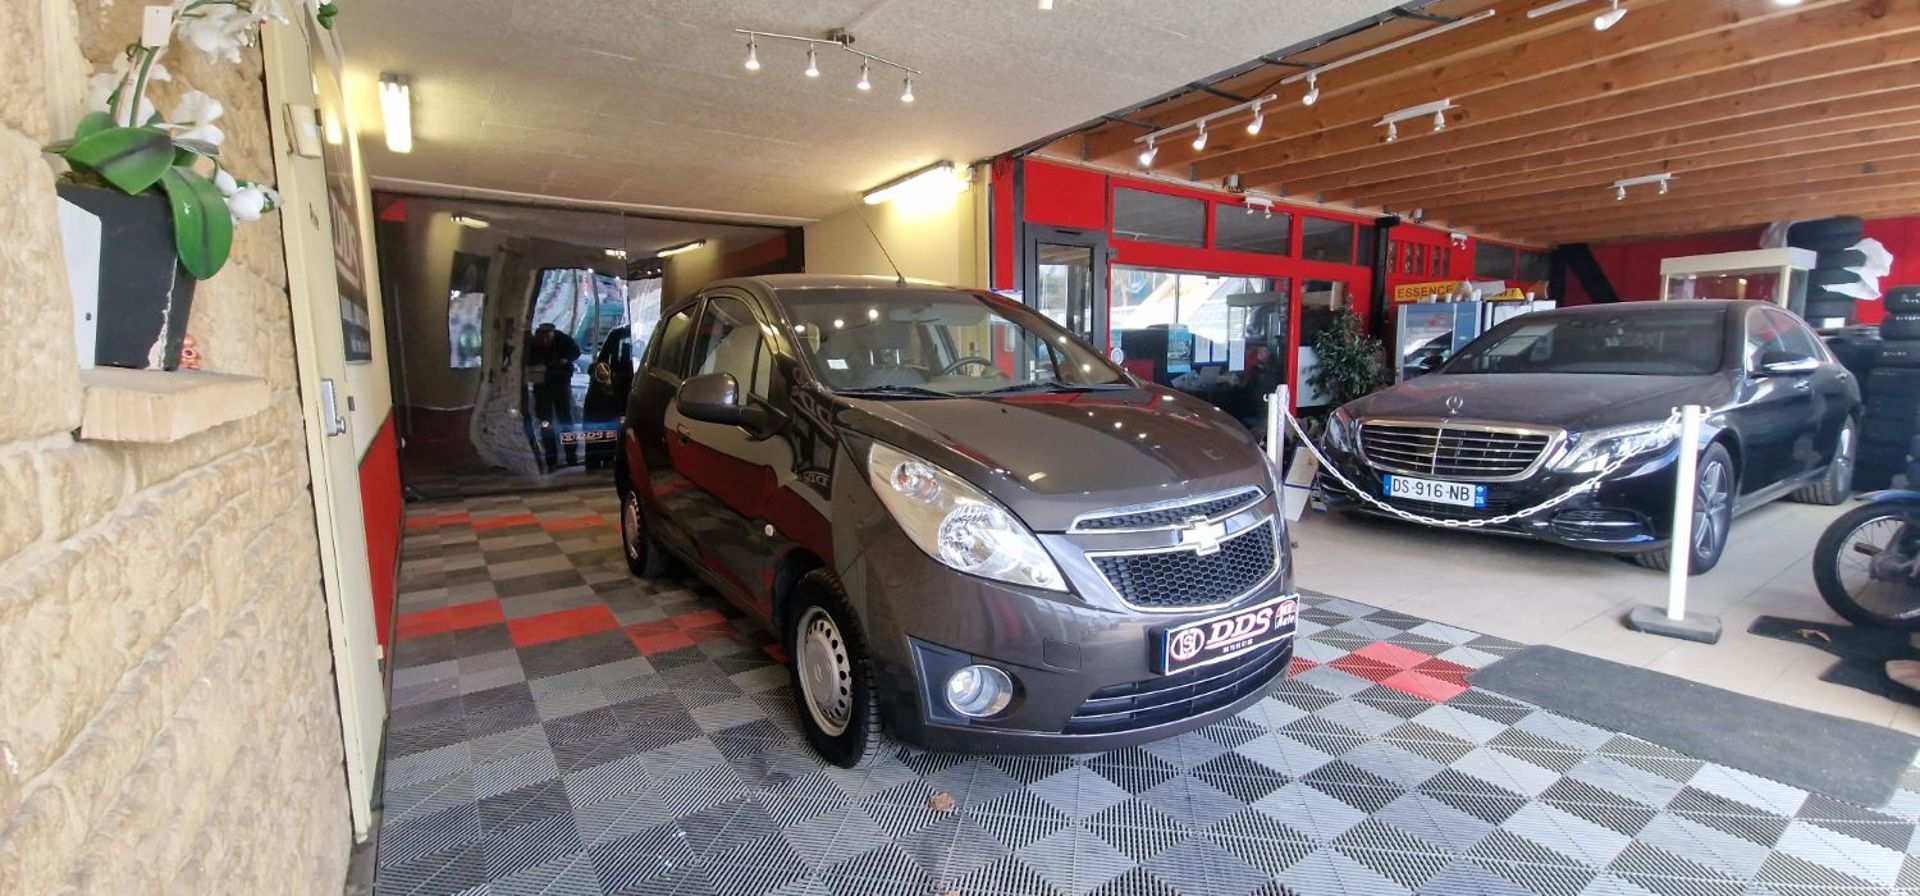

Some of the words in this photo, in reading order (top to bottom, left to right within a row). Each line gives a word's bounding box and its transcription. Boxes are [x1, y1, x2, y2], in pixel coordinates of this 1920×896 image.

[1397, 284, 1454, 298] ESSENCE
[1393, 478, 1470, 502] DS-916-NB
[1208, 607, 1273, 642] DDS
